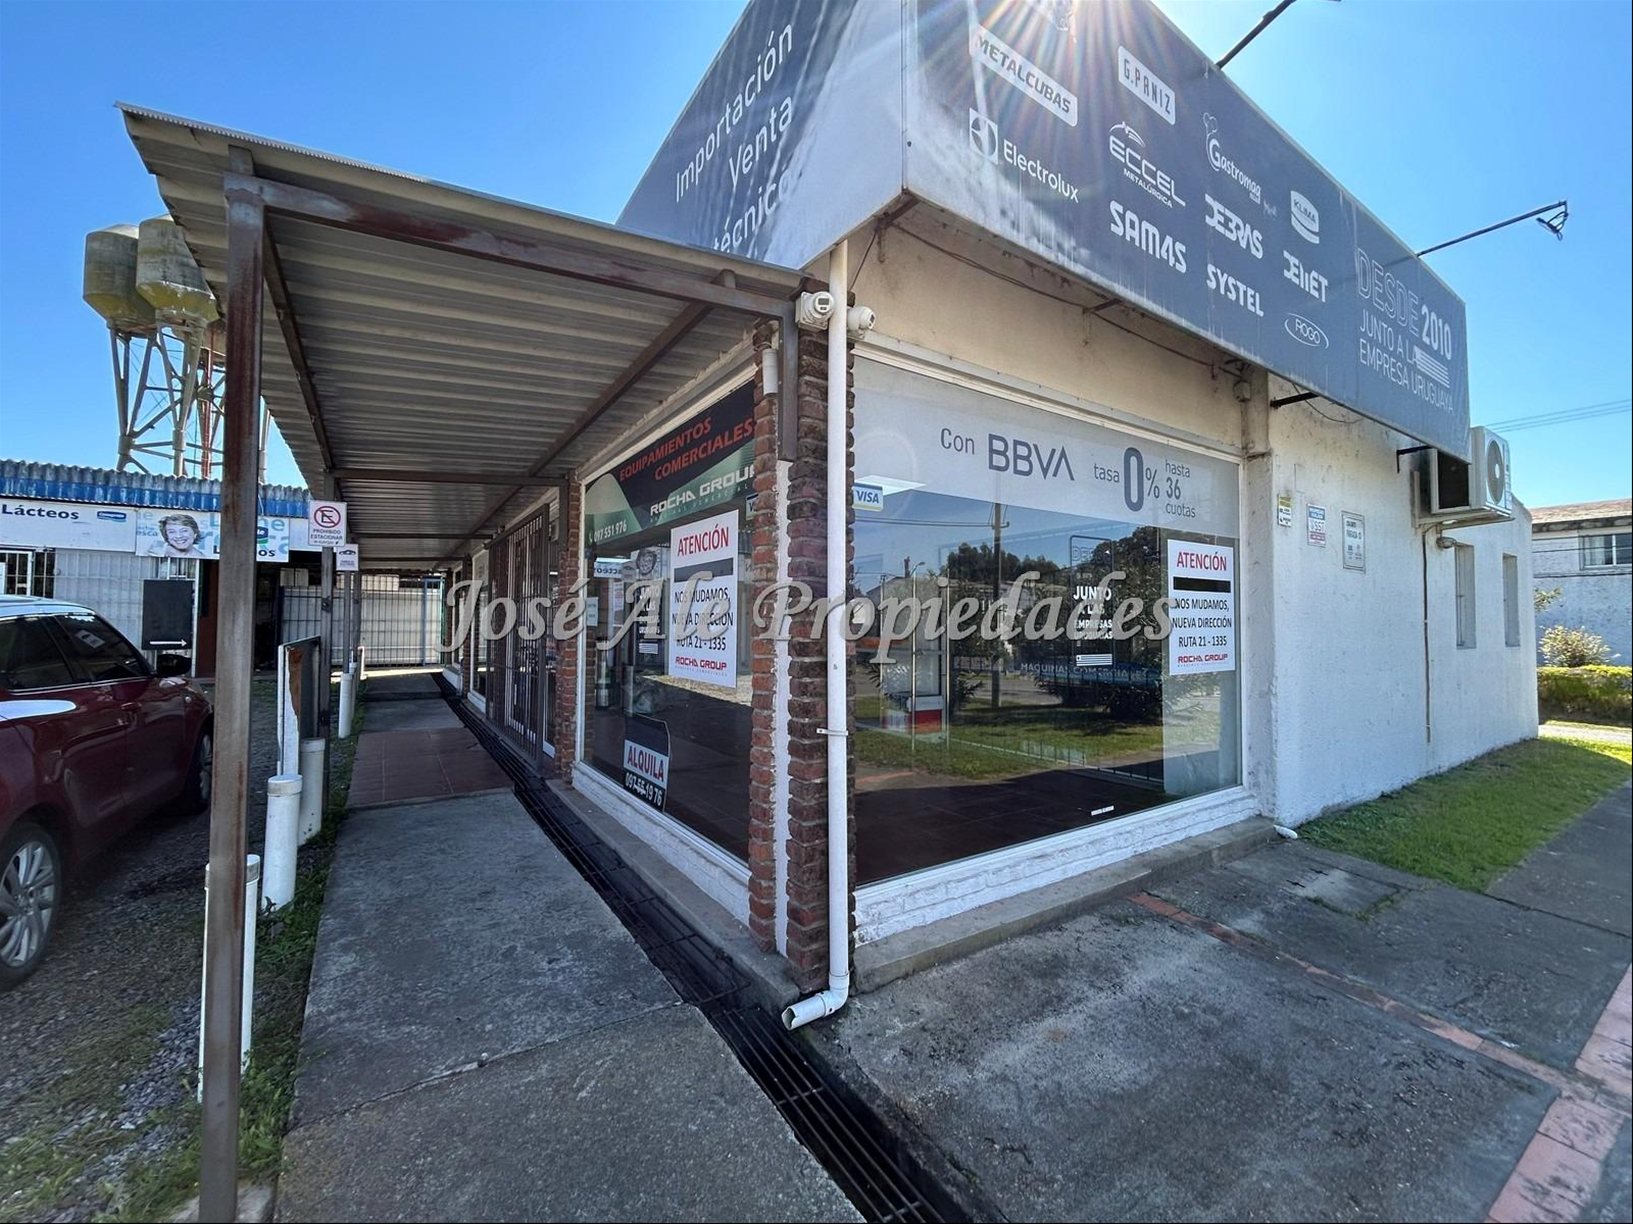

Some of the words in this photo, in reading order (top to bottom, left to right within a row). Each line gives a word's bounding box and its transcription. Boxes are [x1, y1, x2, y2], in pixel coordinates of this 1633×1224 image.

[976, 34, 1071, 114] METALCUBAS
[676, 24, 792, 202] Importación
[729, 96, 792, 189] Venta
[1003, 139, 1079, 203] Electrolux
[1109, 135, 1186, 207] ECCEL
[1206, 263, 1264, 317] SYSTEL
[1358, 248, 1419, 338] DESDE
[1421, 304, 1452, 360] 2010
[1360, 308, 1395, 351] JUNTO
[1397, 334, 1404, 359] A
[1406, 339, 1418, 365] LA
[1359, 338, 1409, 390] EMPRESA
[619, 417, 712, 481] EQUIPAMIENTOS
[654, 416, 755, 481] COMERCIALES
[940, 428, 975, 455] Con
[988, 433, 1075, 481] BBVA
[1094, 463, 1120, 484] tasa
[1165, 459, 1191, 479] hasta
[856, 490, 879, 504] VISA
[1166, 476, 1181, 500] 36
[1, 504, 79, 520] Lácteos
[650, 490, 696, 517] ROCHA
[1165, 502, 1196, 519] cuotas
[677, 524, 729, 557] ATENCIÓN
[1176, 551, 1227, 571] ATENCIÓN
[1174, 598, 1190, 609] NOS
[1172, 618, 1196, 628] NUEVA
[1198, 616, 1232, 628] DIRECCIÓN
[695, 636, 702, 649] 21
[709, 637, 727, 651] 1335
[1178, 636, 1197, 648] RUTA
[1199, 636, 1206, 647] 21
[1212, 635, 1228, 646] 1335
[675, 656, 698, 667] ROCHA
[700, 659, 727, 671] GROUP
[1177, 655, 1203, 663] ROCHA
[1204, 653, 1228, 662] GROUP
[627, 745, 664, 783] ALQUILA
